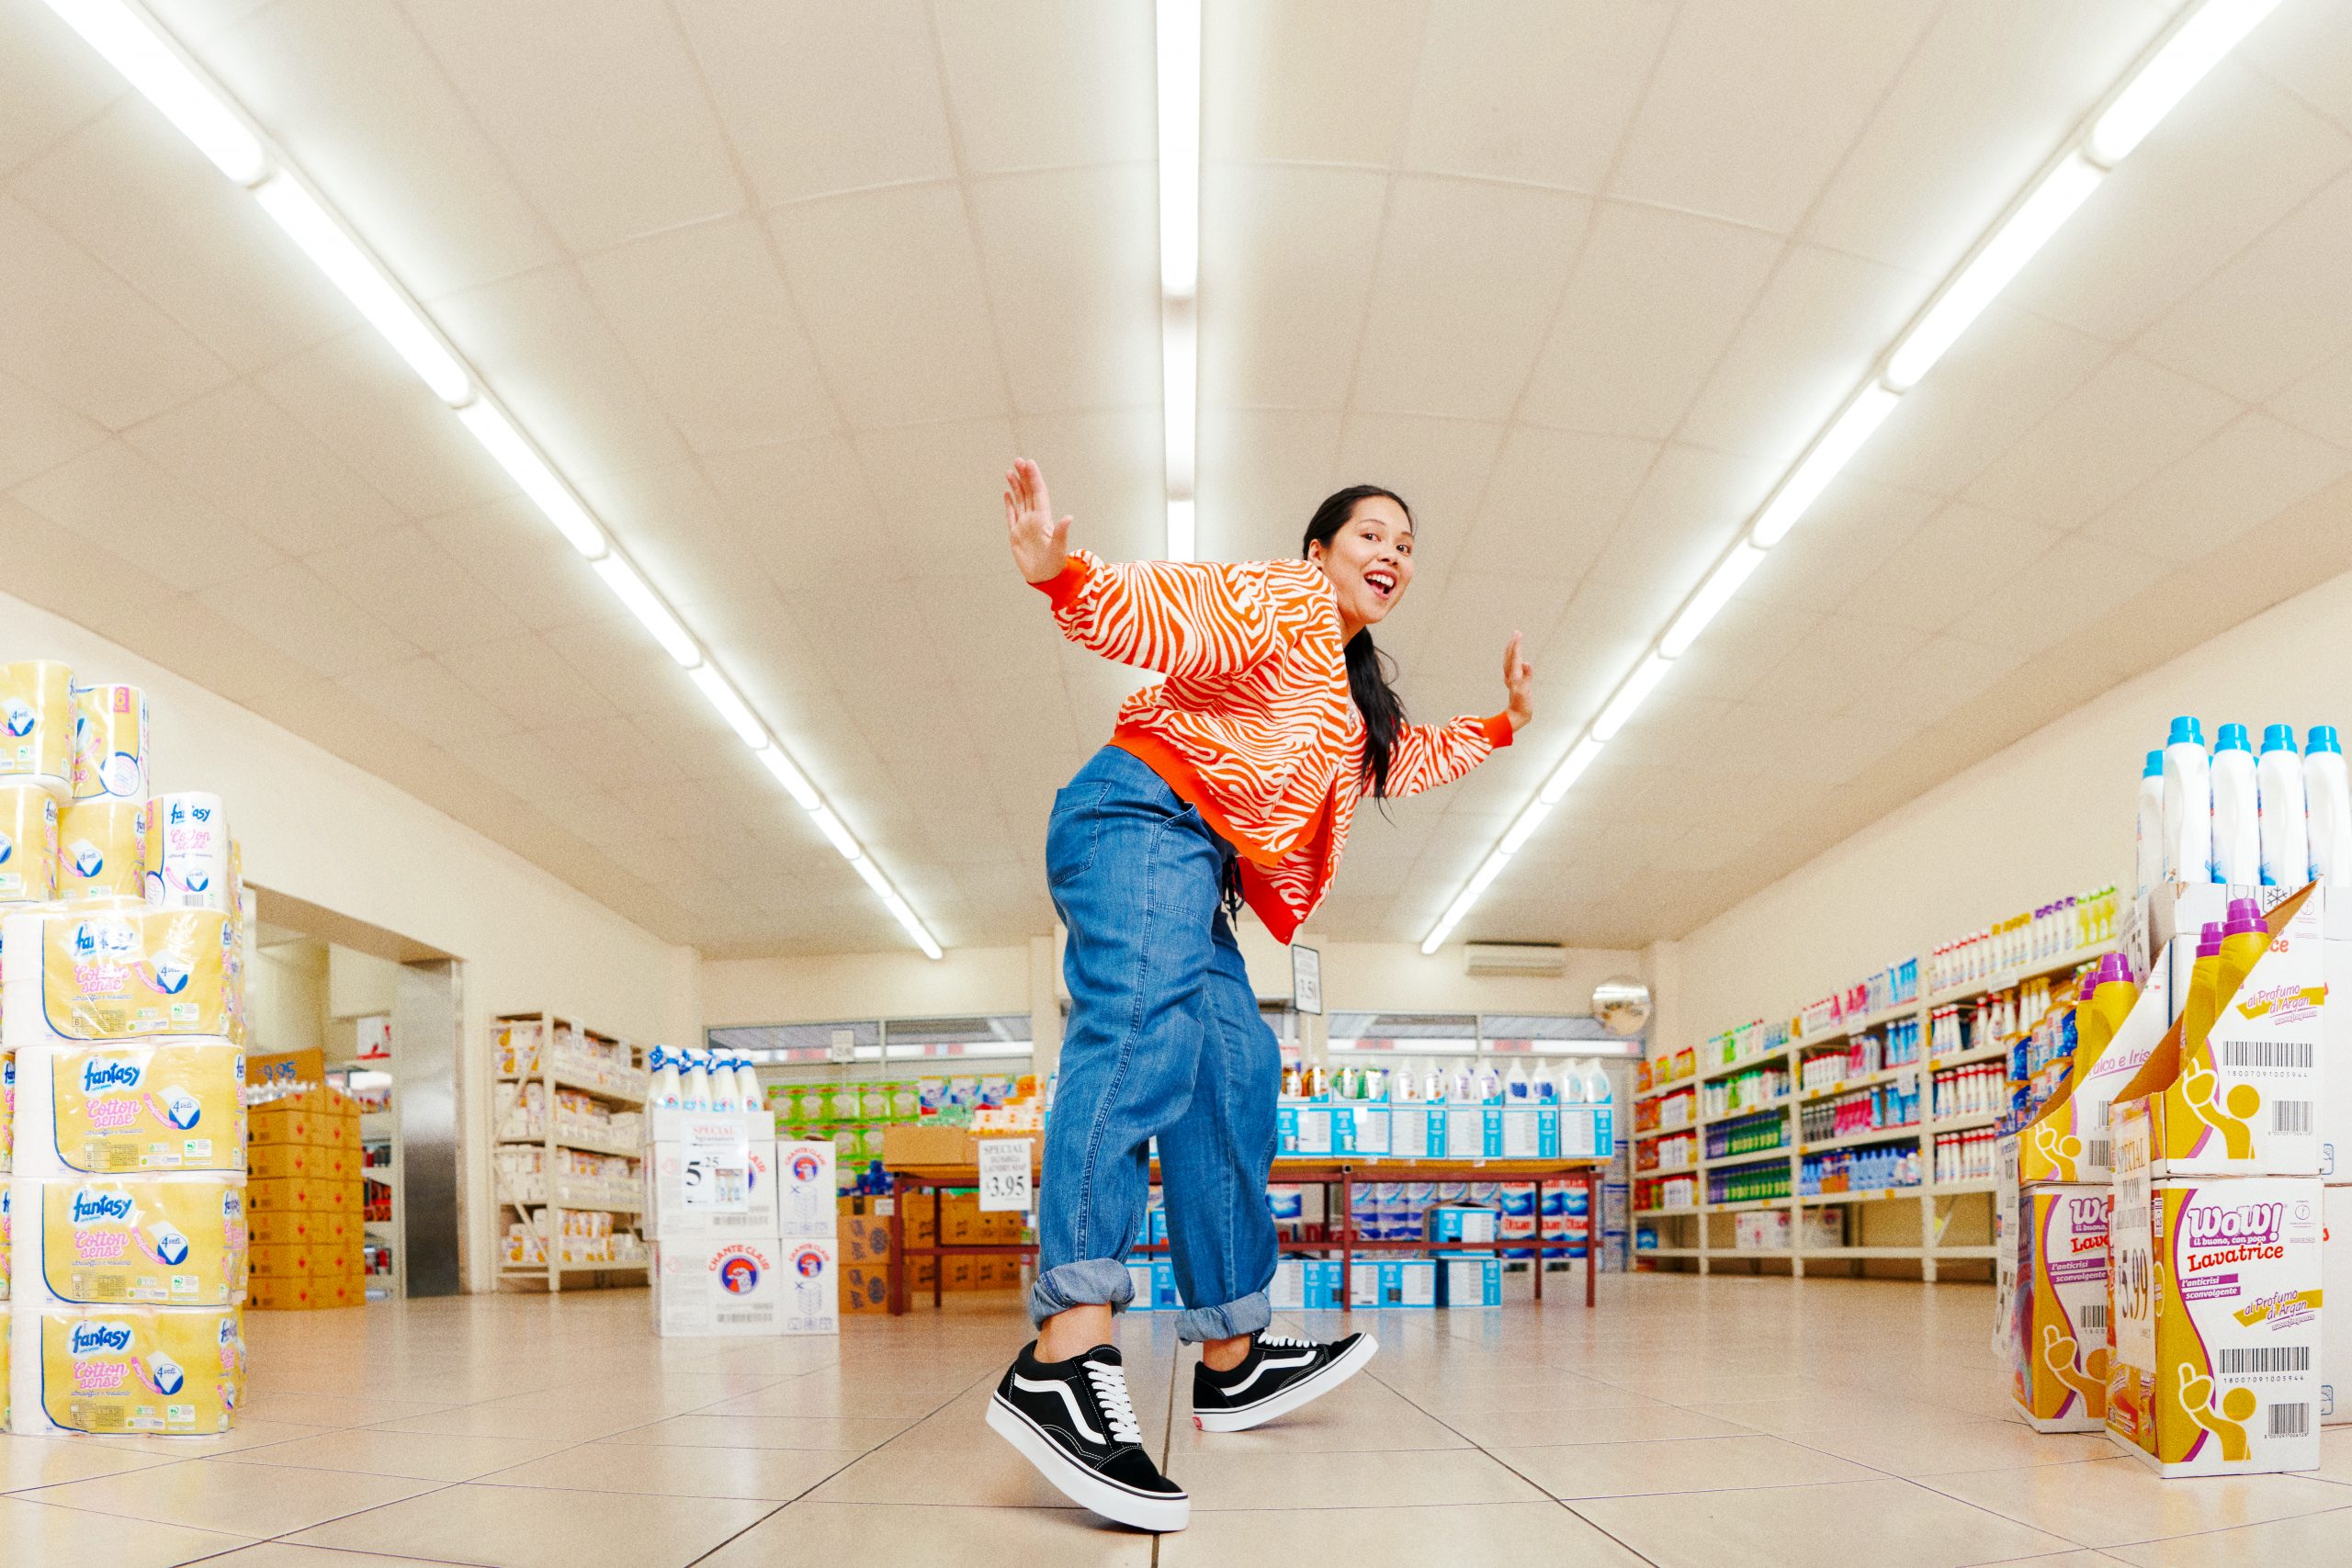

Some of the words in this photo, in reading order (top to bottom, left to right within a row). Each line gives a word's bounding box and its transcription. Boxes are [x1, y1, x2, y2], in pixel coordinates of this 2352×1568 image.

[171, 803, 210, 824] faasy
[82, 980, 122, 993] sense
[2248, 995, 2256, 1008] al
[2256, 985, 2301, 1002] Profumo
[2270, 999, 2278, 1014] di
[2281, 996, 2309, 1012] Argan
[2088, 1056, 2115, 1076] alco
[2119, 1057, 2125, 1067] e
[2129, 1049, 2150, 1065] Iris
[85, 1061, 141, 1091] fantasy
[85, 1100, 141, 1119] Cotton
[173, 1101, 179, 1112] 4
[94, 1114, 134, 1128] sense
[2117, 1138, 2145, 1175] SPECIAL
[74, 1192, 132, 1223] fantasy
[74, 1231, 129, 1249] Cotton
[162, 1236, 168, 1247] 4
[2202, 1237, 2230, 1247] buono,
[2247, 1235, 2267, 1245] poco
[81, 1247, 122, 1258] sense
[708, 1245, 743, 1271] CHANTE
[745, 1246, 771, 1270] CLAIR
[2188, 1241, 2284, 1272] Lavatrice
[2052, 1260, 2088, 1271] l'anticrisi
[2056, 1271, 2107, 1282] sconvolgente
[2181, 1276, 2220, 1288] l'anticrisi
[2186, 1287, 2238, 1300] sconvolgente
[2245, 1303, 2253, 1314] al
[2256, 1291, 2298, 1311] Profumo
[2267, 1305, 2277, 1320] di
[2279, 1302, 2307, 1316] Argan
[73, 1325, 131, 1353] fantasy
[74, 1361, 129, 1380] Cotton
[157, 1367, 164, 1378] 4
[2224, 1375, 2304, 1384] 18007091005944
[80, 1377, 121, 1389] sense
